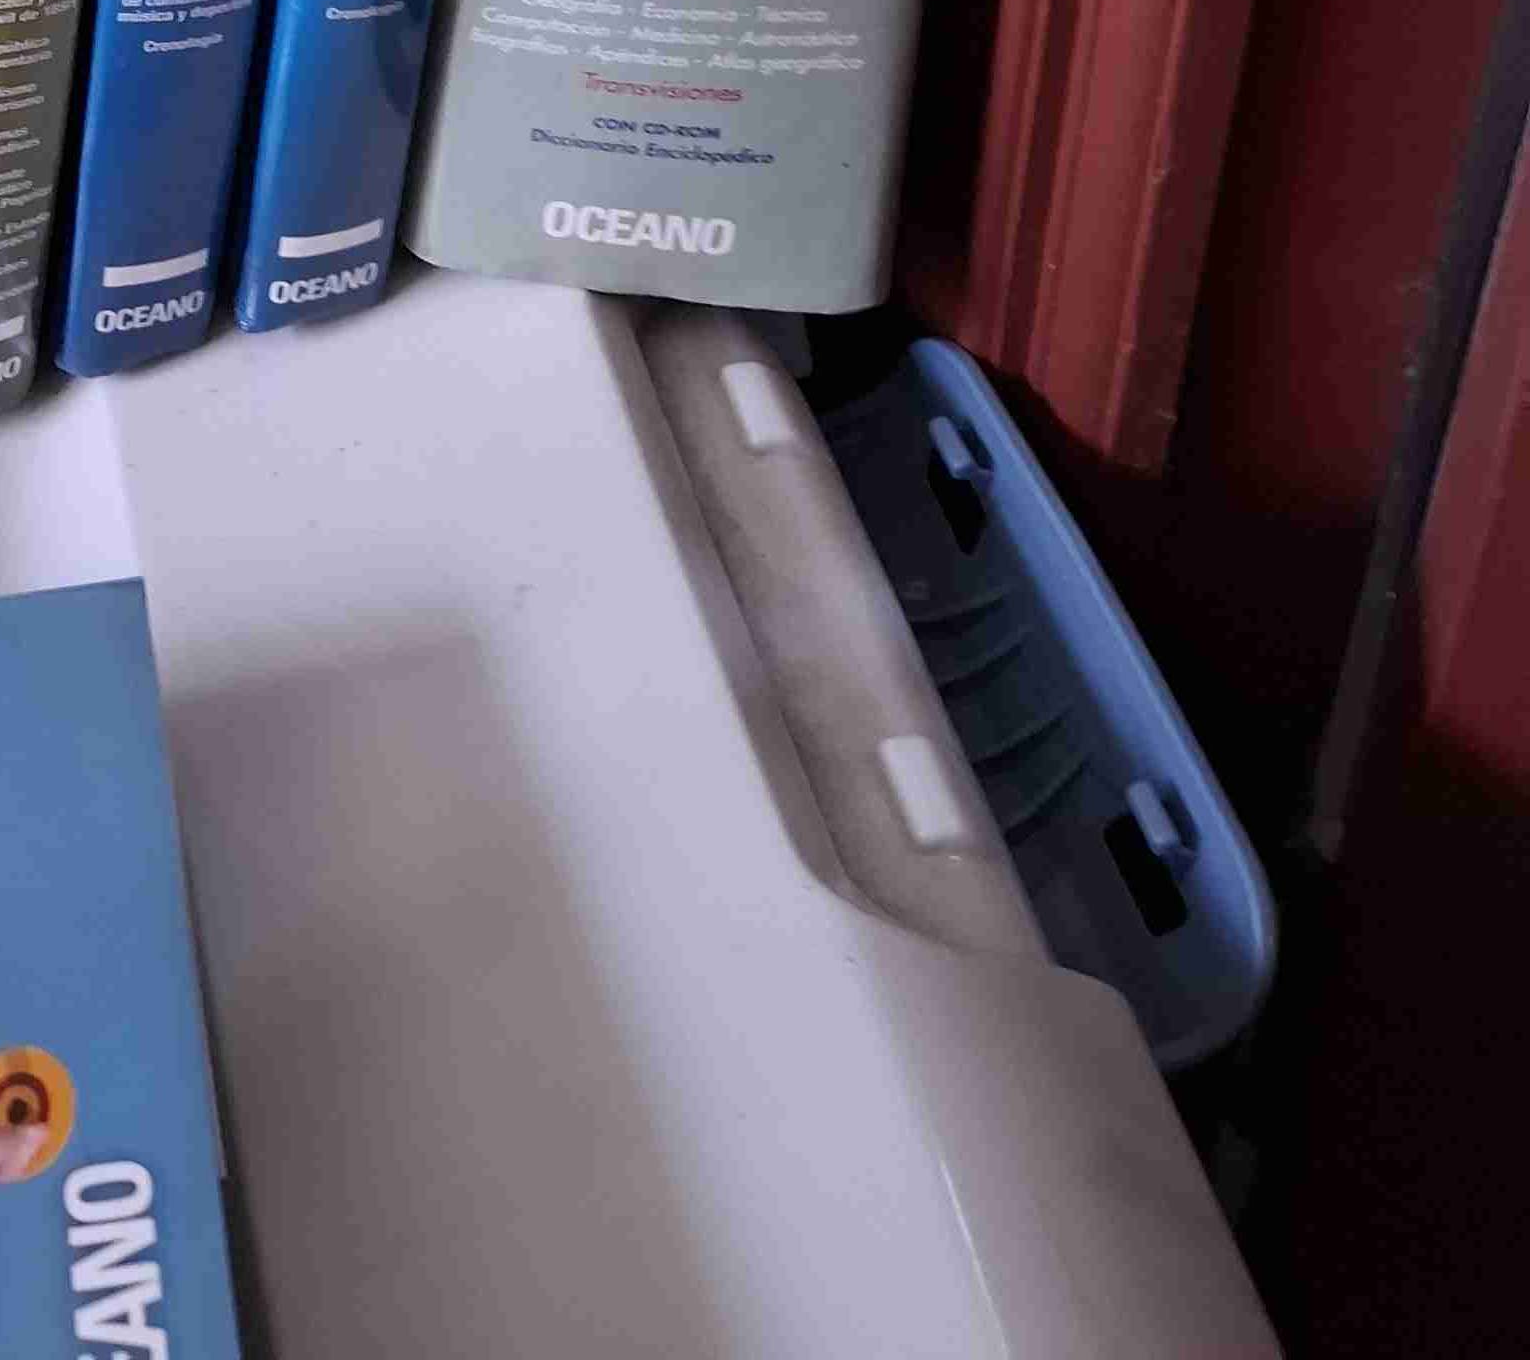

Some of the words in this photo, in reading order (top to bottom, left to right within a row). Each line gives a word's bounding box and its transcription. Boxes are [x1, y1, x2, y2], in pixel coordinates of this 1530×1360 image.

[530, 128, 640, 155] Diccionario
[542, 200, 737, 256] OCEANO
[269, 262, 379, 305] OCEANO
[94, 290, 206, 333] OCEANO
[63, 1159, 168, 1360] ANO
